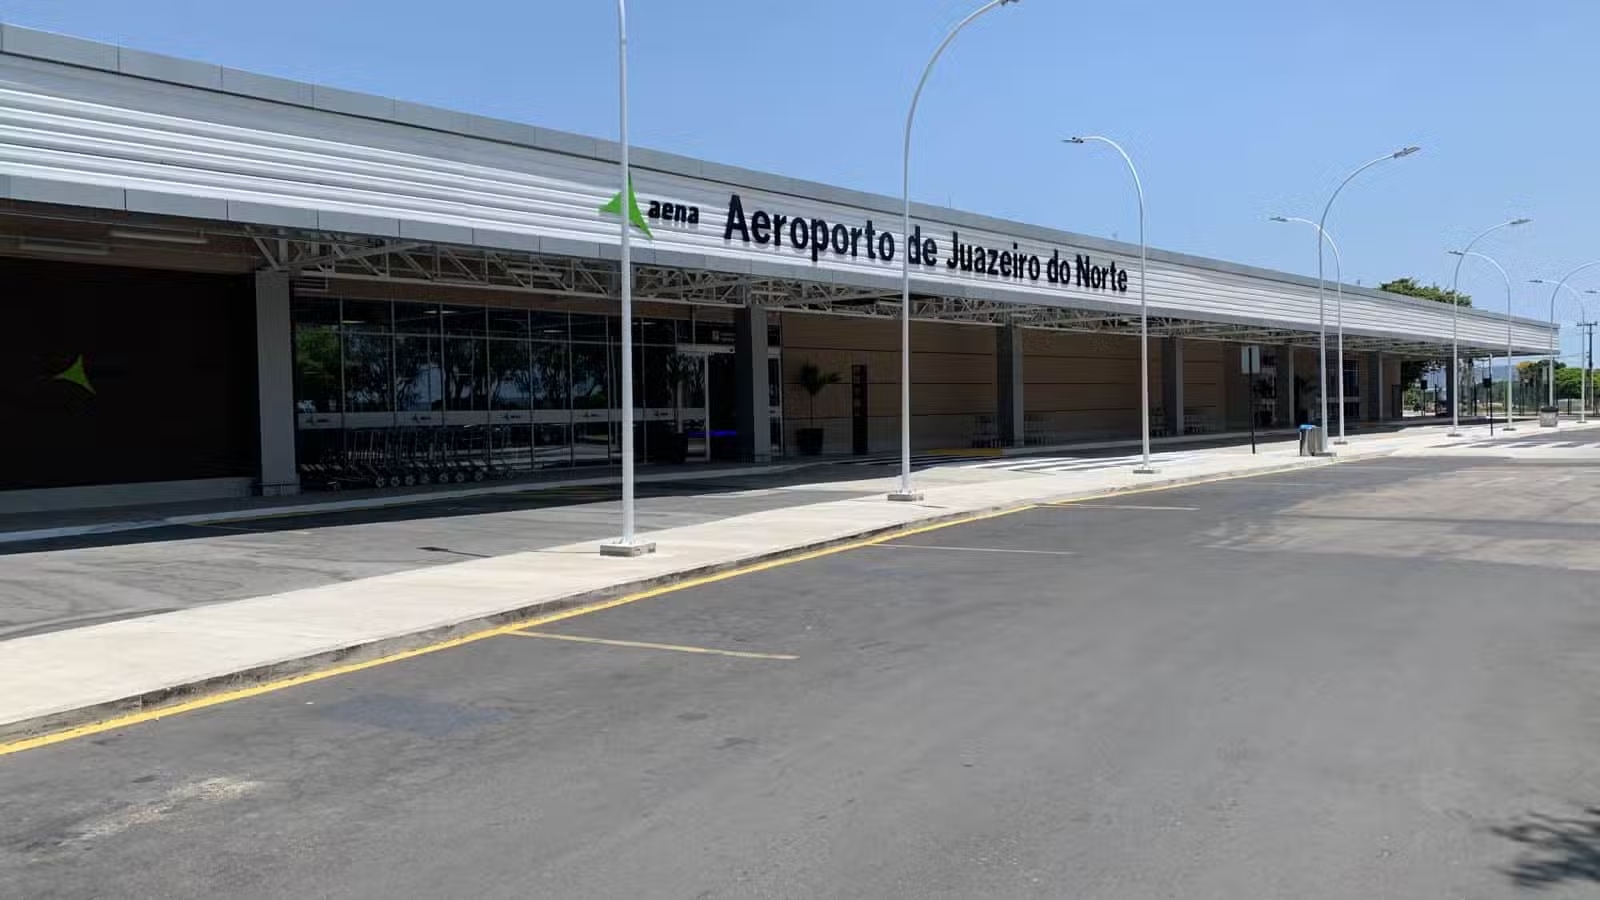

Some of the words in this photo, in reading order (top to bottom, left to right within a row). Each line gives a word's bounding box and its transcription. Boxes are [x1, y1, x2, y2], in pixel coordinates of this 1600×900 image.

[648, 200, 700, 224] aena
[724, 194, 896, 263] Aeroporto
[907, 224, 938, 267] de
[947, 231, 1041, 281] Juazeiro
[1047, 249, 1071, 285] do
[1076, 254, 1128, 292] Norte
